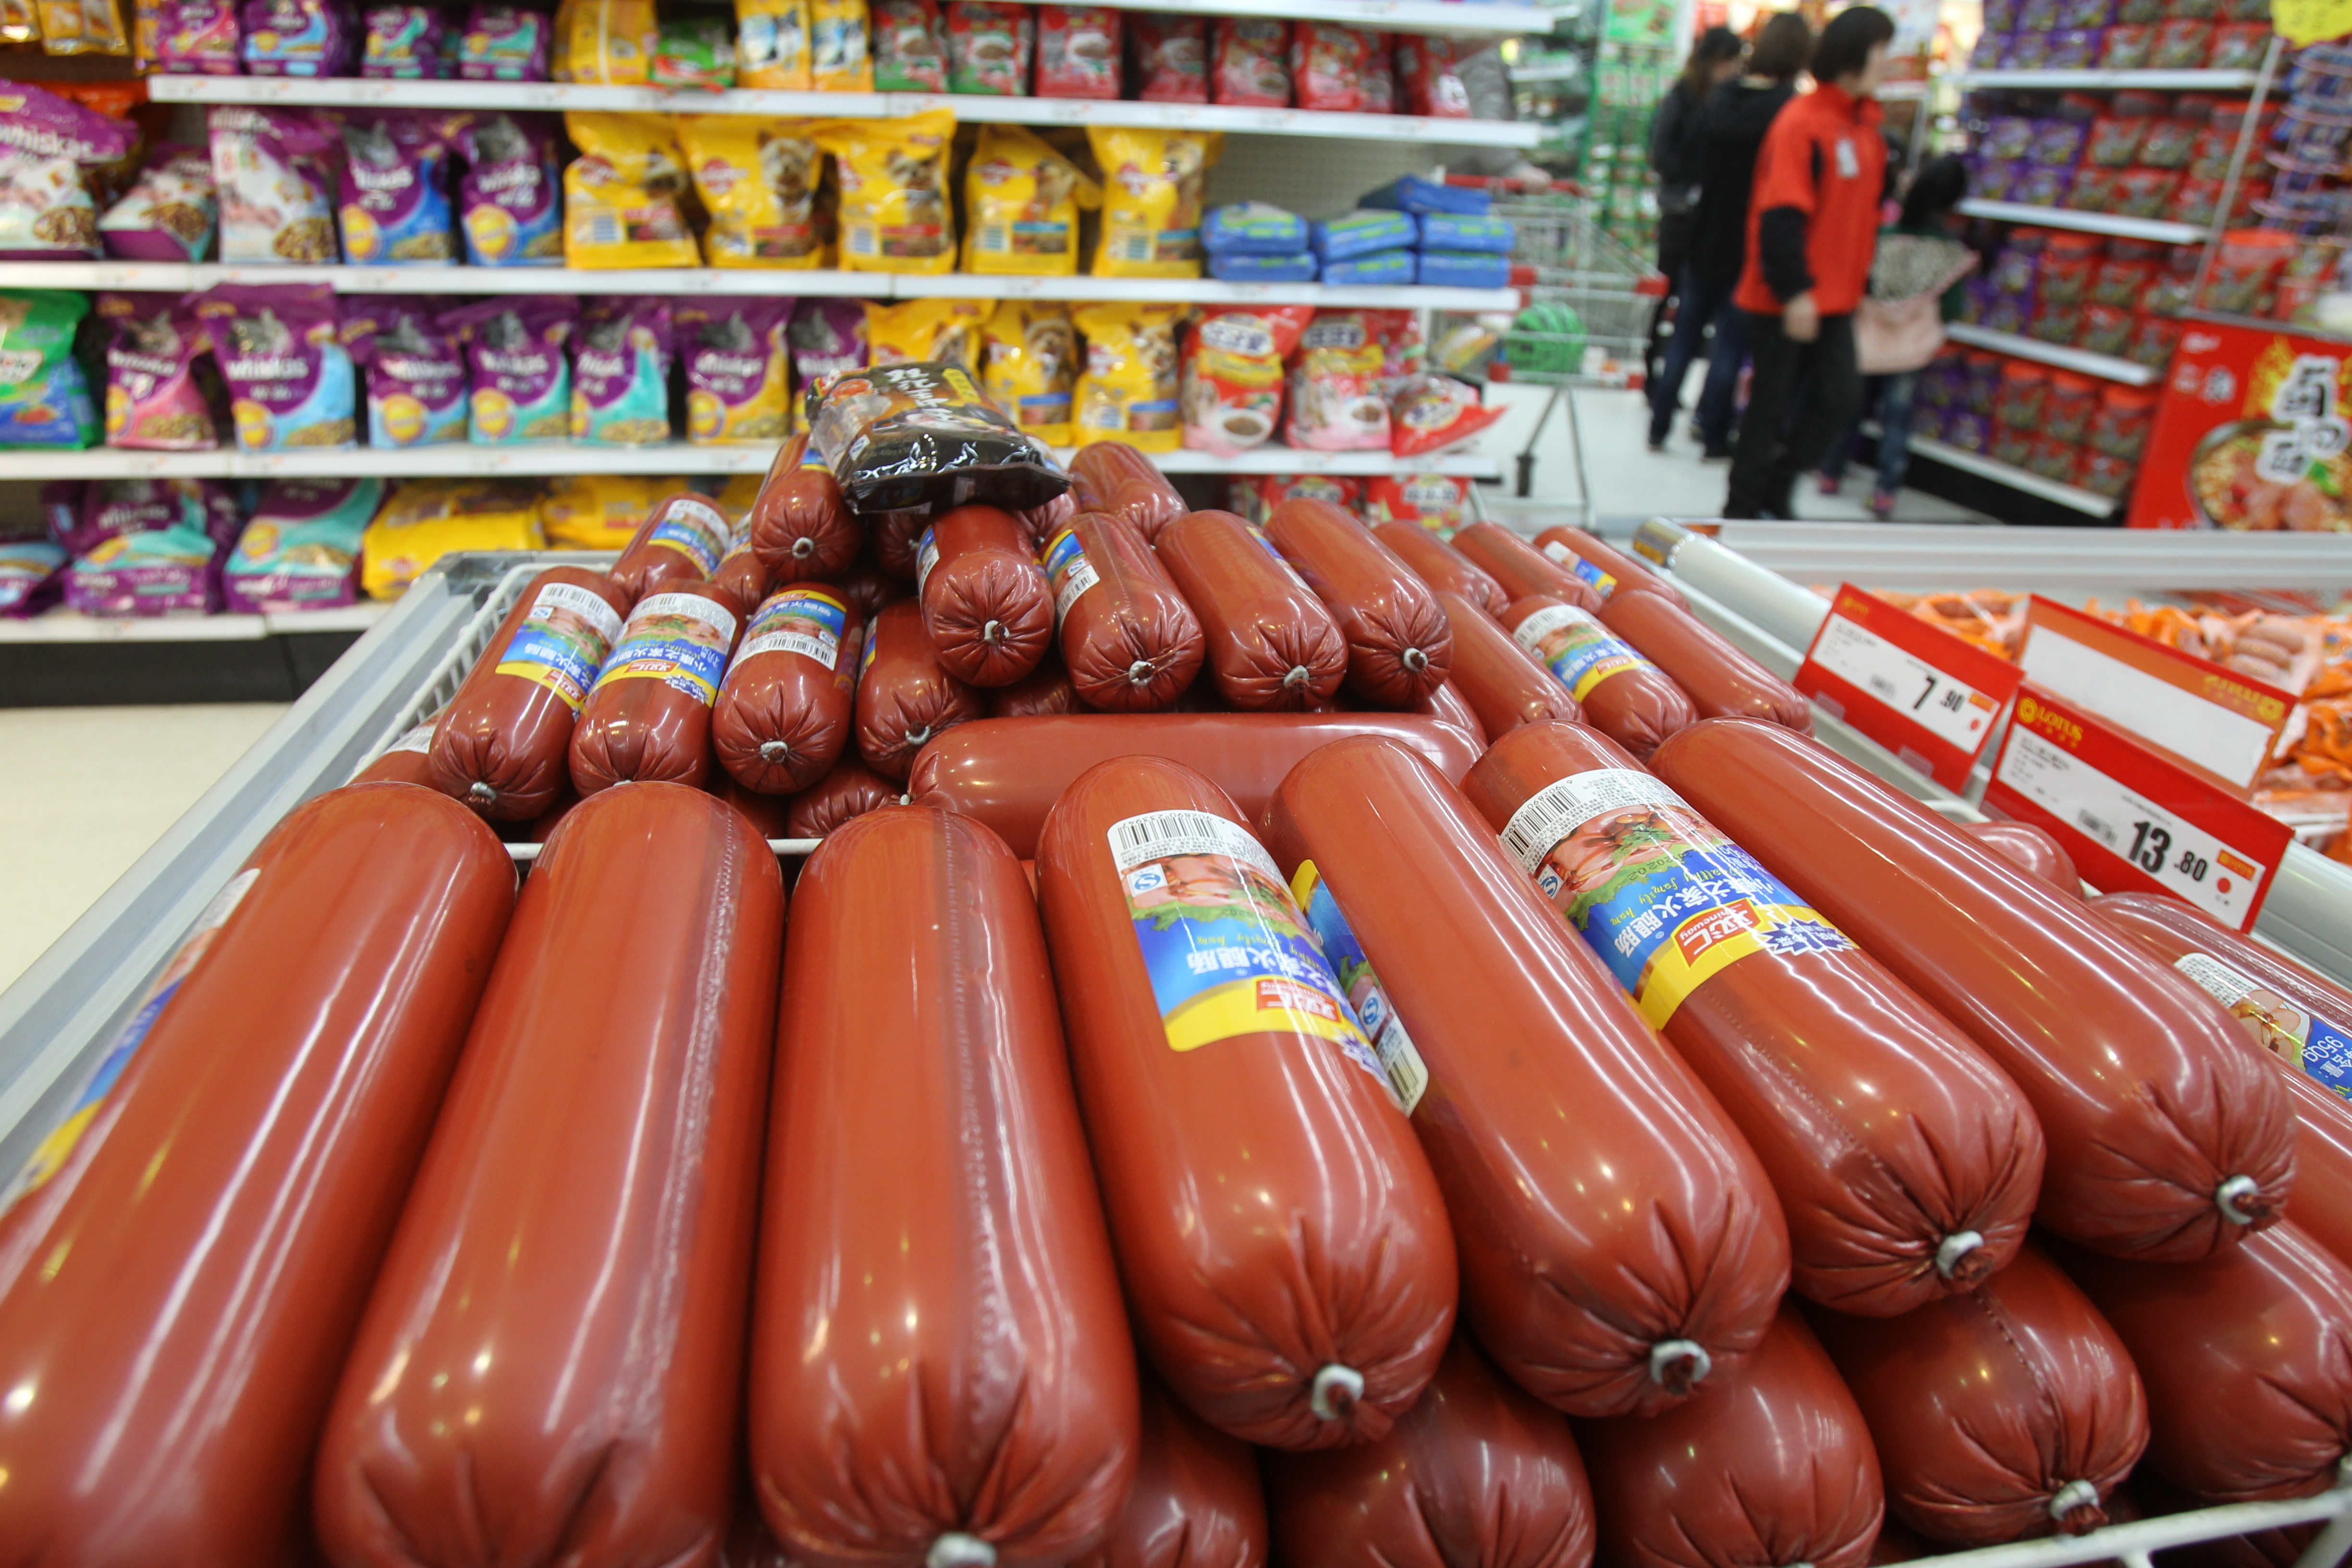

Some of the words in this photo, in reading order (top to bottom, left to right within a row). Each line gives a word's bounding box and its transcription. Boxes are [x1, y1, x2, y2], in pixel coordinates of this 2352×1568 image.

[1914, 675, 1936, 710] 7
[1942, 689, 1965, 712] .90
[1527, 785, 1561, 810] 902890
[1121, 814, 1166, 828] 233947
[2128, 821, 2172, 873] 13
[2174, 849, 2208, 882] .80
[1639, 878, 1678, 905] family
[1610, 906, 1636, 926] ham
[1683, 909, 1753, 956] 双汇
[2301, 1036, 2344, 1062] 950g
